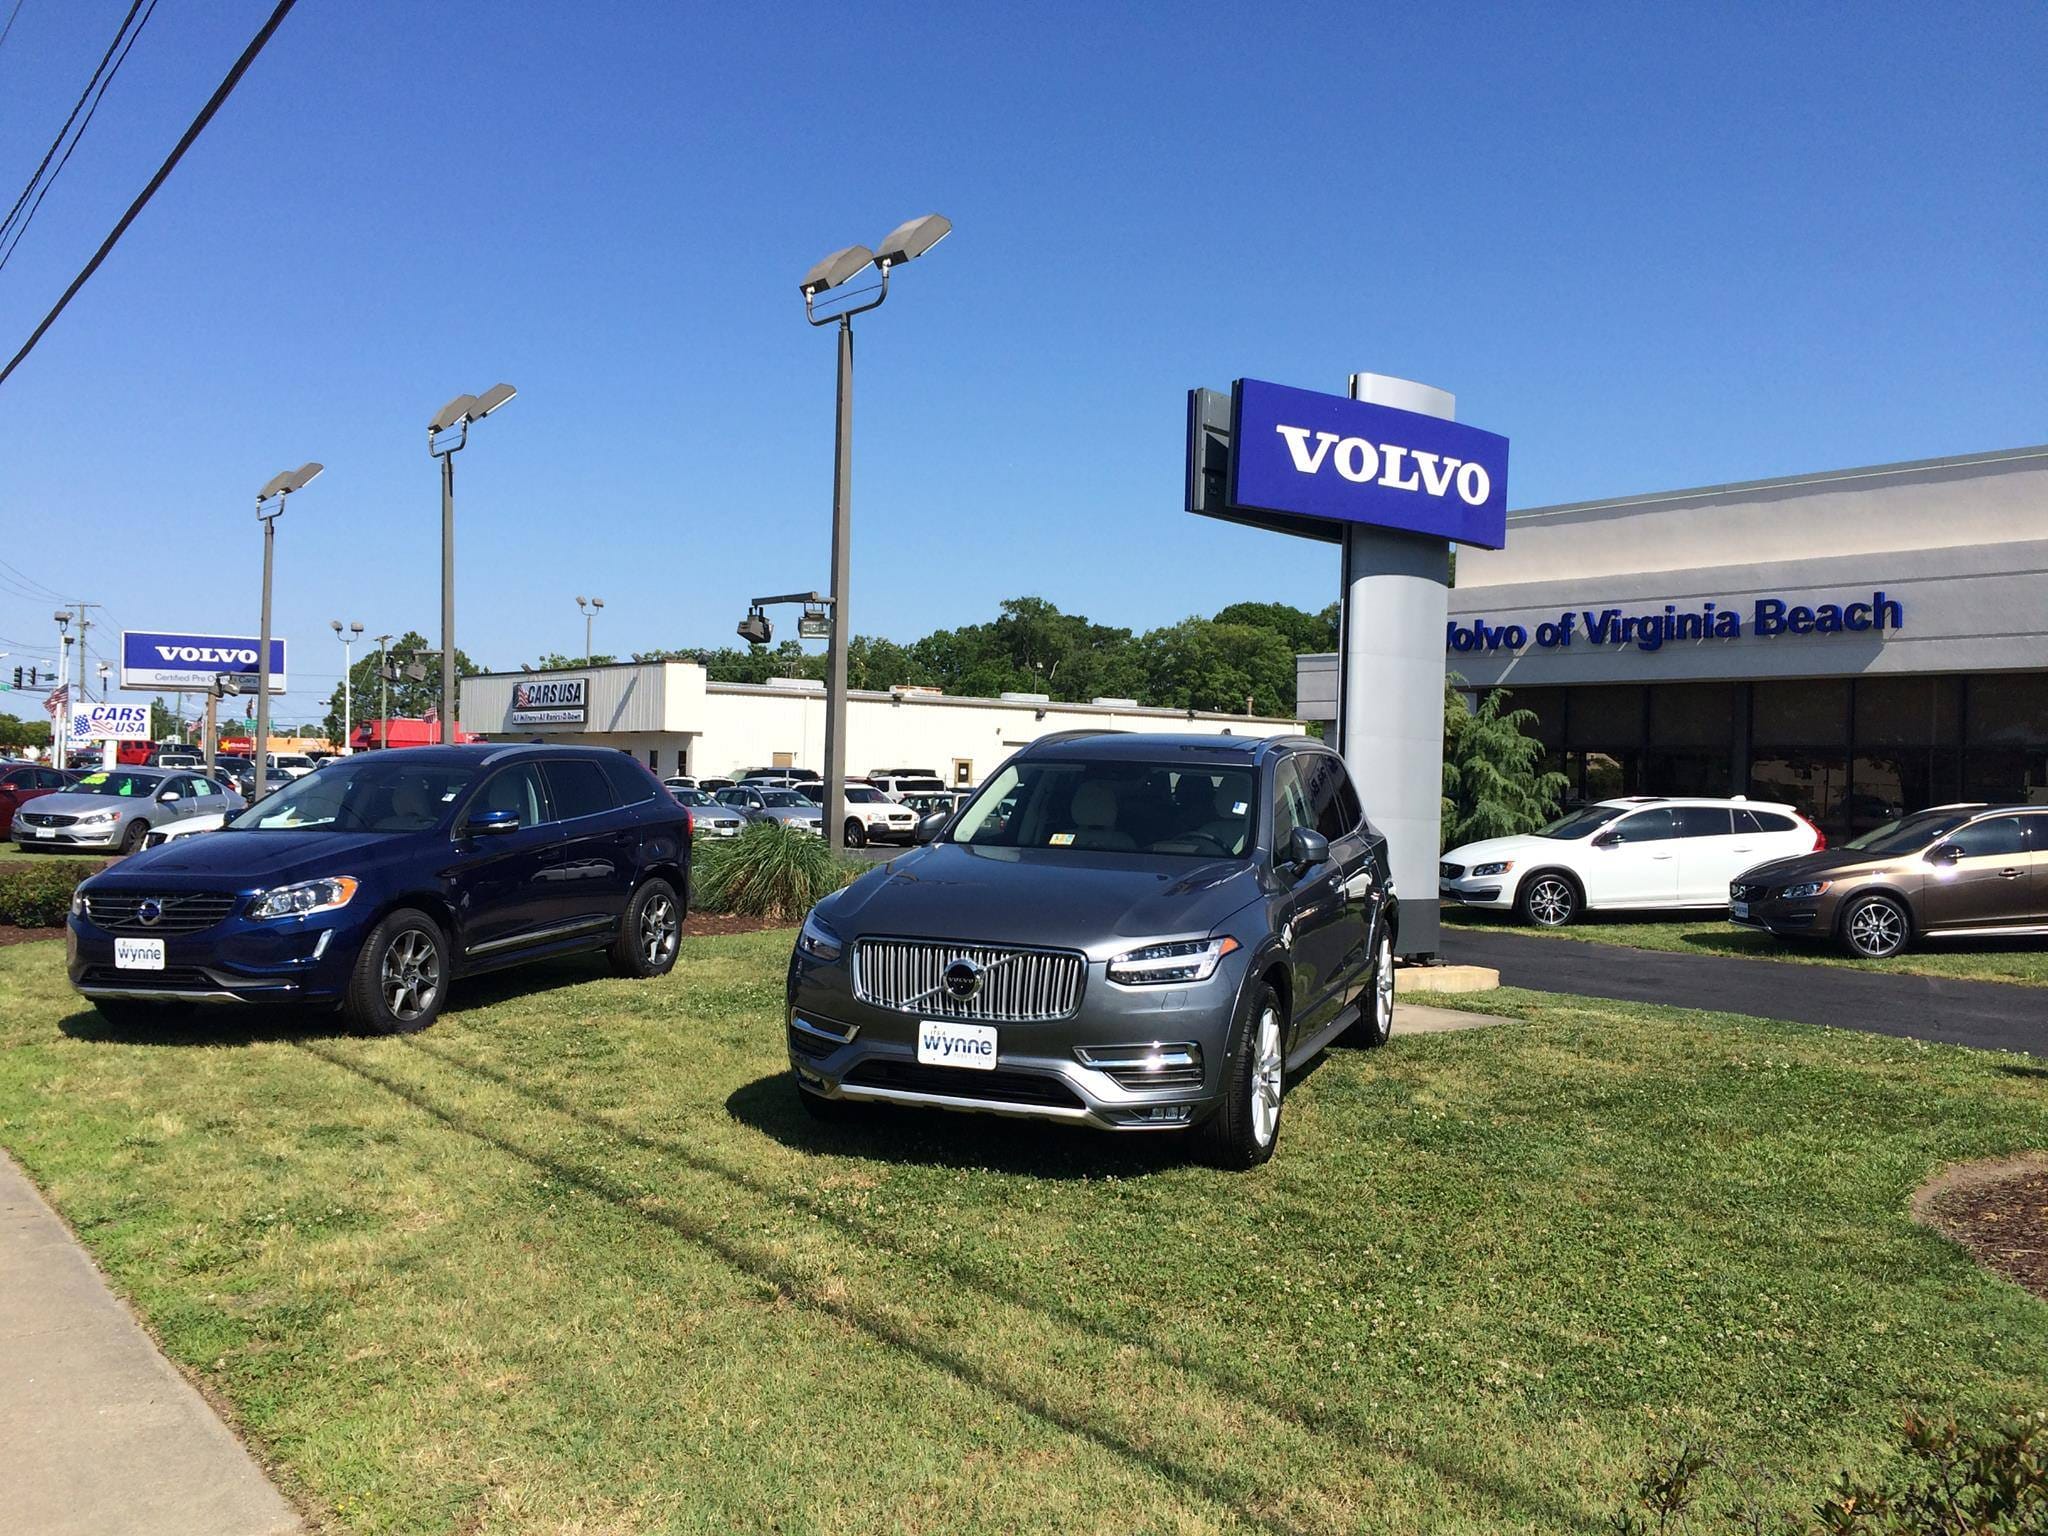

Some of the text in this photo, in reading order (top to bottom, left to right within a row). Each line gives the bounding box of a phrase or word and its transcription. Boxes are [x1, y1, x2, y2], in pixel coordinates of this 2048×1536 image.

[1275, 424, 1491, 506] VOLVO
[1535, 611, 1577, 647] of
[1582, 603, 1742, 652] Virginia
[1754, 591, 1904, 637] Beach
[154, 645, 258, 664] VOLVO
[154, 673, 190, 682] Certified
[191, 674, 206, 683] Pre
[528, 683, 582, 704] CARS USA
[91, 706, 147, 722] CARS
[115, 721, 145, 733] USA
[118, 948, 161, 962] wynne
[923, 1034, 993, 1056] wynne
